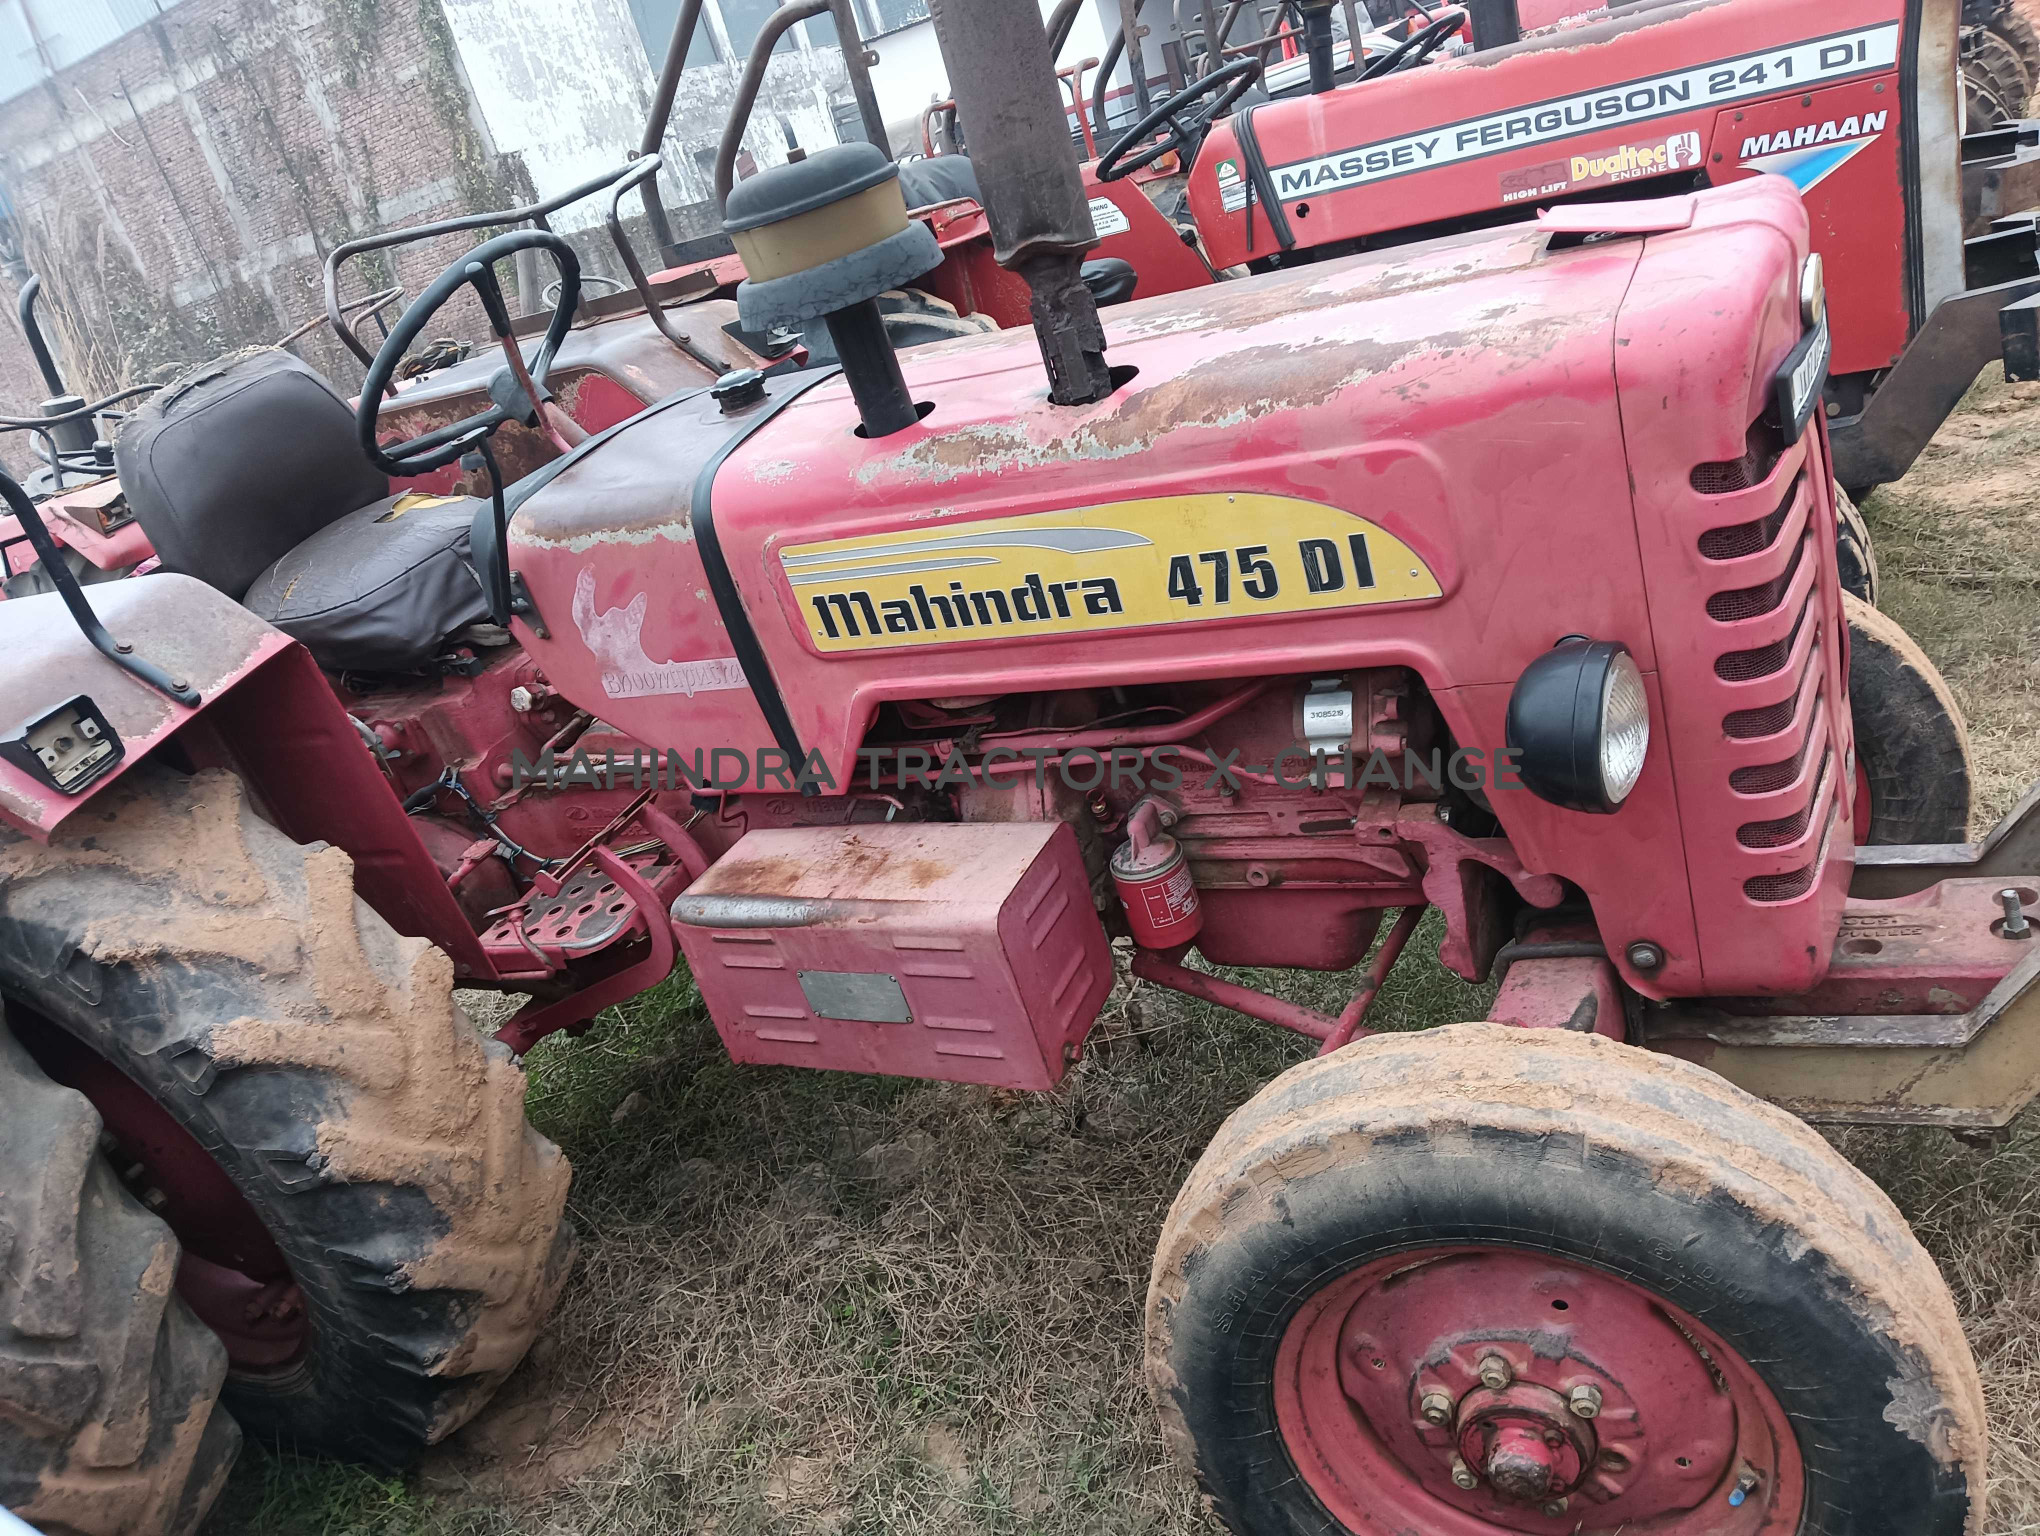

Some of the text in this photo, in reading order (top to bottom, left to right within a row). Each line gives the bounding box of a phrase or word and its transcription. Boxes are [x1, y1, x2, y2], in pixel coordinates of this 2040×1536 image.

[1281, 39, 1866, 193] MASSEY FERGUSON 241 DI
[1738, 110, 1888, 158] MAHAAN
[1571, 144, 1667, 182] Dualtec
[1611, 163, 1668, 182] ENGINE
[1503, 182, 1568, 202] HIGH LIFT
[812, 532, 1376, 640] Mahindra 475 DI
[1310, 709, 1344, 719] 31085219
